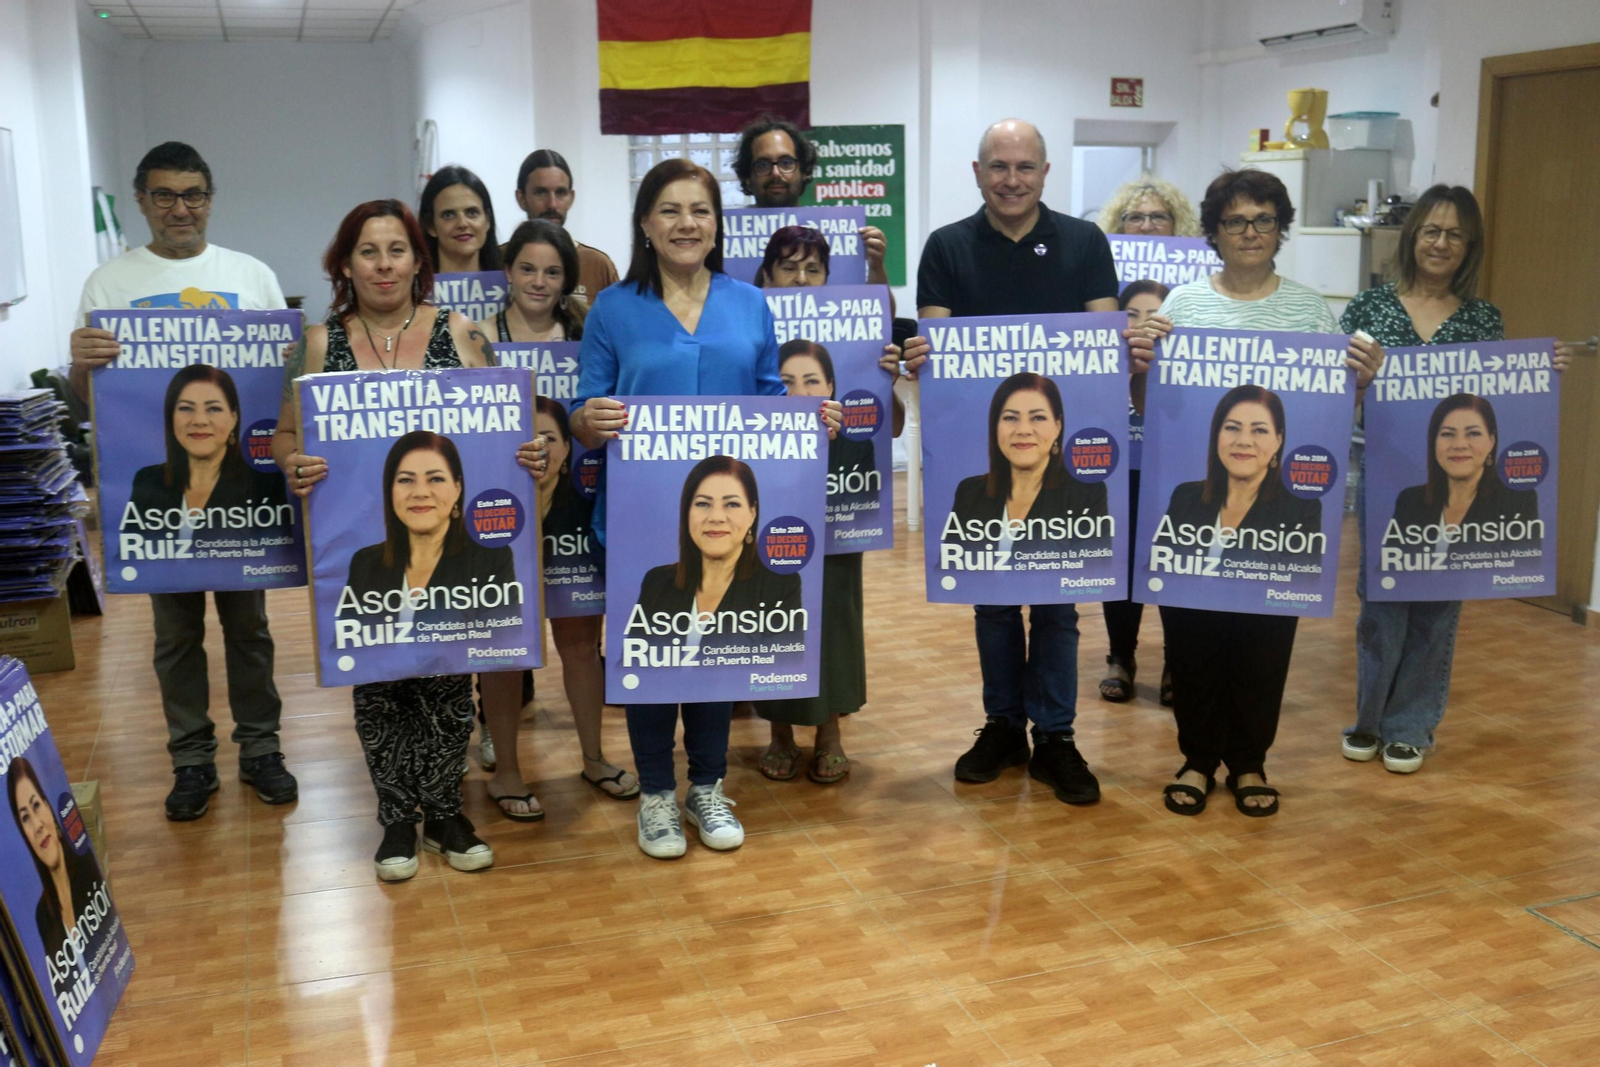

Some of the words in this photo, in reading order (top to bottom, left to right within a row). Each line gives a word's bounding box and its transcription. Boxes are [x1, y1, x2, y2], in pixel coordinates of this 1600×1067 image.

[825, 158, 895, 177] sanidad
[816, 179, 885, 203] pública
[723, 213, 798, 236] ALENTÍA
[820, 219, 858, 234] PARA
[1111, 240, 1167, 262] ENTÍA
[434, 277, 485, 303] NTÍA
[766, 292, 819, 319] NTÍA
[841, 298, 883, 317] PARA
[100, 315, 222, 342] VALENTÍA
[247, 324, 293, 341] PARA
[774, 317, 883, 344] SFORMAR
[929, 322, 1048, 352] VALENTÍA
[1073, 328, 1120, 347] PARA
[1161, 334, 1277, 364] VALENTÍA
[1302, 348, 1349, 367] PARA
[1506, 351, 1551, 370] PARA
[930, 349, 1120, 378] TRANSFORMAR
[1158, 360, 1346, 394] TRANSFORMAR
[1373, 370, 1550, 402] TRANSFORMAR
[311, 379, 444, 413] VALENTÍA
[471, 384, 521, 405] PARA
[313, 405, 522, 442] TRANSFORMAR
[770, 412, 819, 431] PARA
[843, 414, 877, 427] VOTAR
[618, 433, 818, 461] TRANSFORMAR
[1072, 454, 1111, 468] VOTAR
[1505, 464, 1542, 477] VOTAR
[1290, 470, 1329, 485] VOTAR
[119, 498, 295, 531] Ascensión
[477, 500, 494, 508] Este
[474, 517, 516, 532] VOTAR
[770, 526, 787, 534] Este
[834, 527, 883, 539] Podemos
[941, 508, 1115, 542] Ascensión
[1152, 514, 1327, 554] Ascensión
[1381, 513, 1545, 545] Ascensión
[119, 533, 194, 560] Ruiz
[480, 532, 512, 540] Podemos
[766, 544, 806, 558] VOTAR
[941, 543, 1012, 571] Ruiz
[1014, 551, 1060, 560] Candidata
[1069, 550, 1077, 558] la
[1078, 548, 1113, 558] Alcaldía
[1150, 545, 1221, 577] Ruiz
[1381, 546, 1448, 571] Ruiz
[243, 564, 298, 575] Podemos
[1014, 562, 1027, 571] de
[1028, 561, 1061, 570] Puerto
[1062, 560, 1084, 569] Real
[1222, 569, 1235, 578] de
[1236, 570, 1269, 581] Puerto
[1269, 572, 1292, 582] Real
[1223, 558, 1269, 570] Candidata
[1270, 563, 1276, 571] a
[1278, 563, 1286, 571] la
[1287, 563, 1322, 573] Alcaldía
[572, 574, 593, 584] Real
[1060, 577, 1116, 588] Podemos
[1493, 574, 1545, 585] Podemos
[335, 575, 524, 617] Ascensión
[1266, 589, 1322, 602] Podemos
[416, 621, 466, 631] Candidata
[475, 620, 484, 628] la
[485, 616, 523, 628] Alcaldía
[623, 601, 808, 635] Ascensión
[335, 615, 415, 649] Ruiz
[417, 634, 430, 643] de
[431, 632, 467, 642] Puerto
[468, 630, 492, 639] Real
[467, 647, 528, 658] Podemos
[623, 637, 700, 668] Ruiz
[702, 645, 750, 655] Candidata
[760, 644, 768, 653] la
[769, 643, 806, 653] Alcaldía
[702, 657, 715, 666] de
[716, 656, 751, 666] Puerto
[752, 655, 775, 664] Real
[750, 673, 808, 684] Podemos
[13, 681, 38, 714] PARA
[45, 880, 112, 997] Ascensión
[56, 967, 97, 1032] Ruiz
